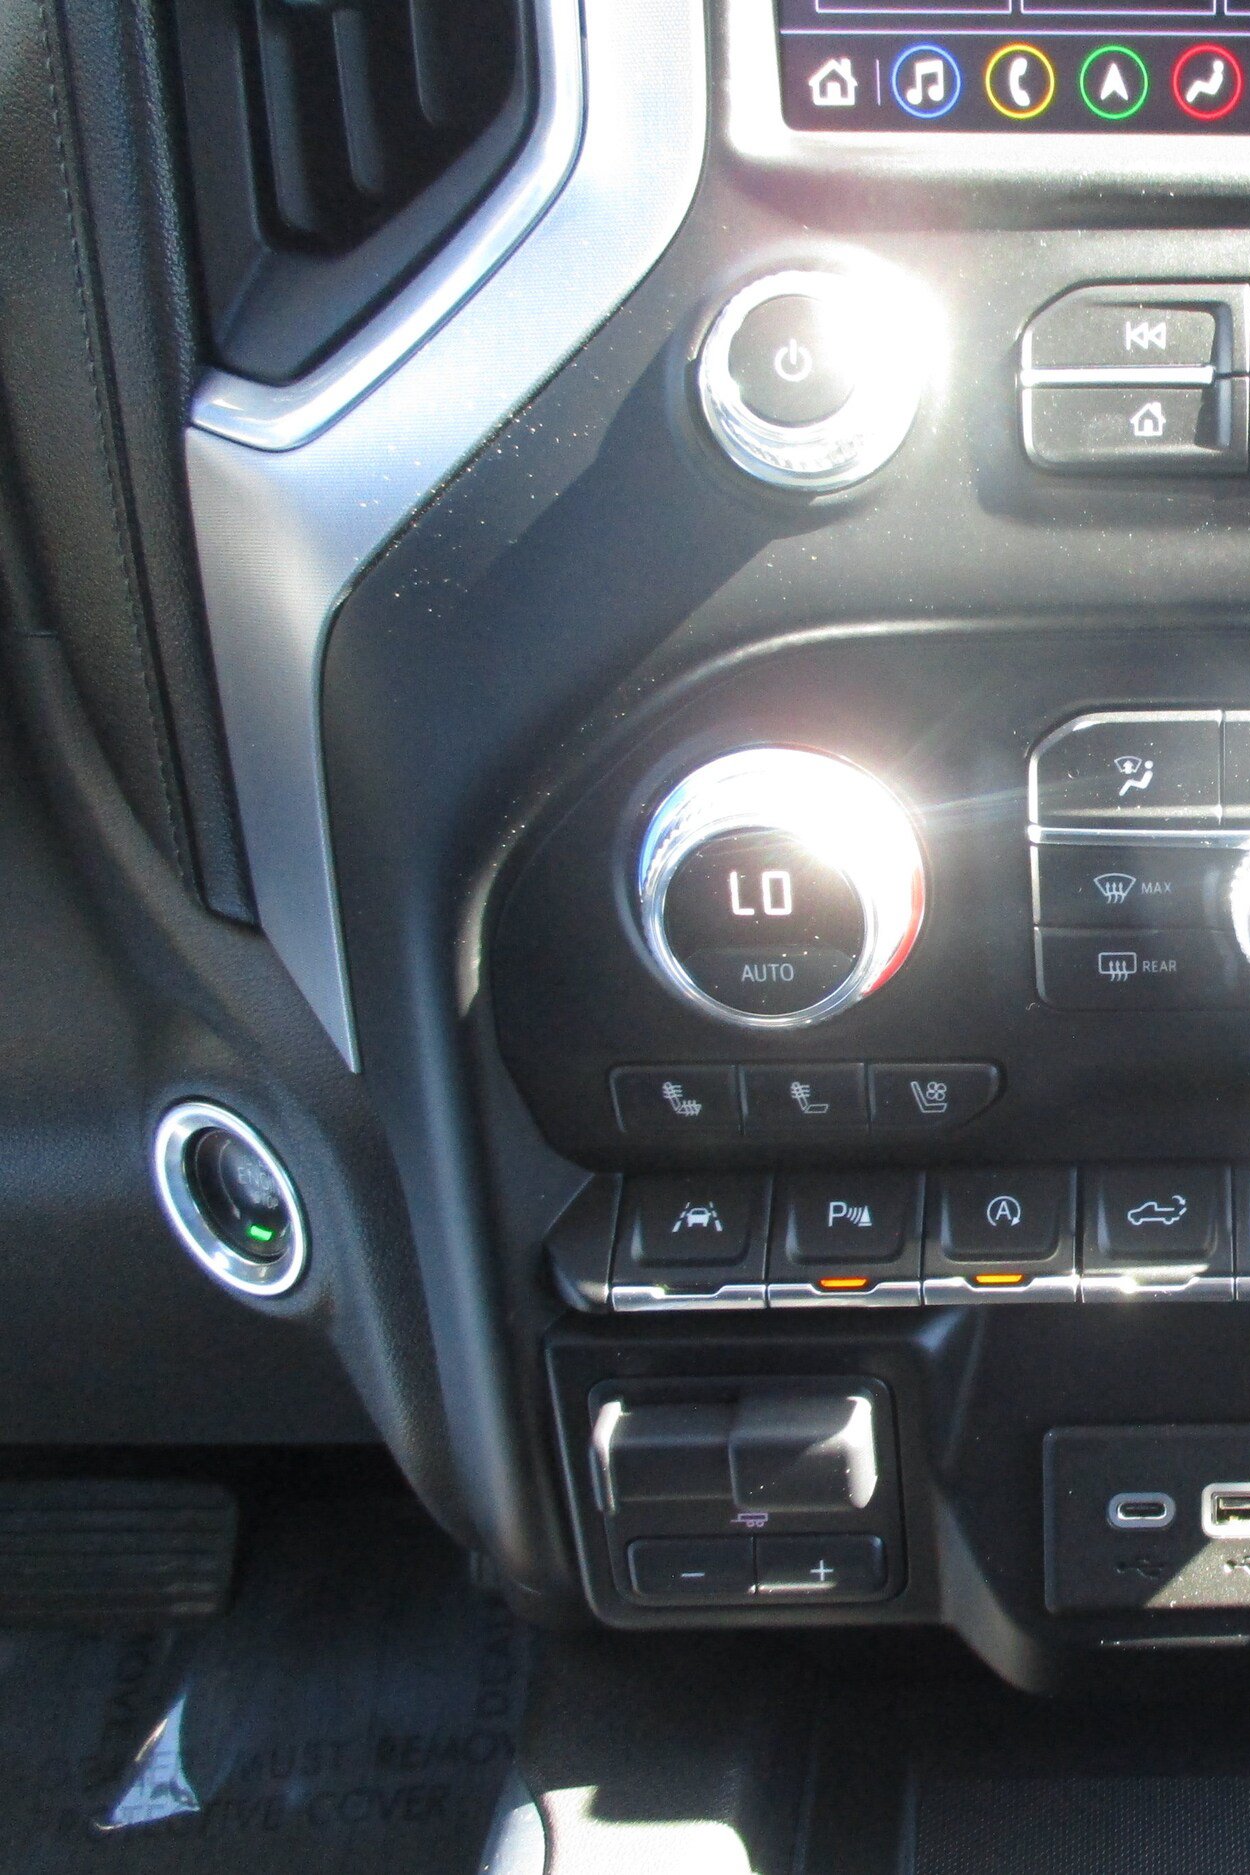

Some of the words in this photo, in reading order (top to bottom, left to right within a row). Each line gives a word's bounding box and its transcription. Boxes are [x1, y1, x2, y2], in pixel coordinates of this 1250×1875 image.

[729, 870, 792, 916] LO
[1141, 882, 1172, 894] MAX
[741, 962, 795, 982] AUTO
[1142, 960, 1177, 973] REAR
